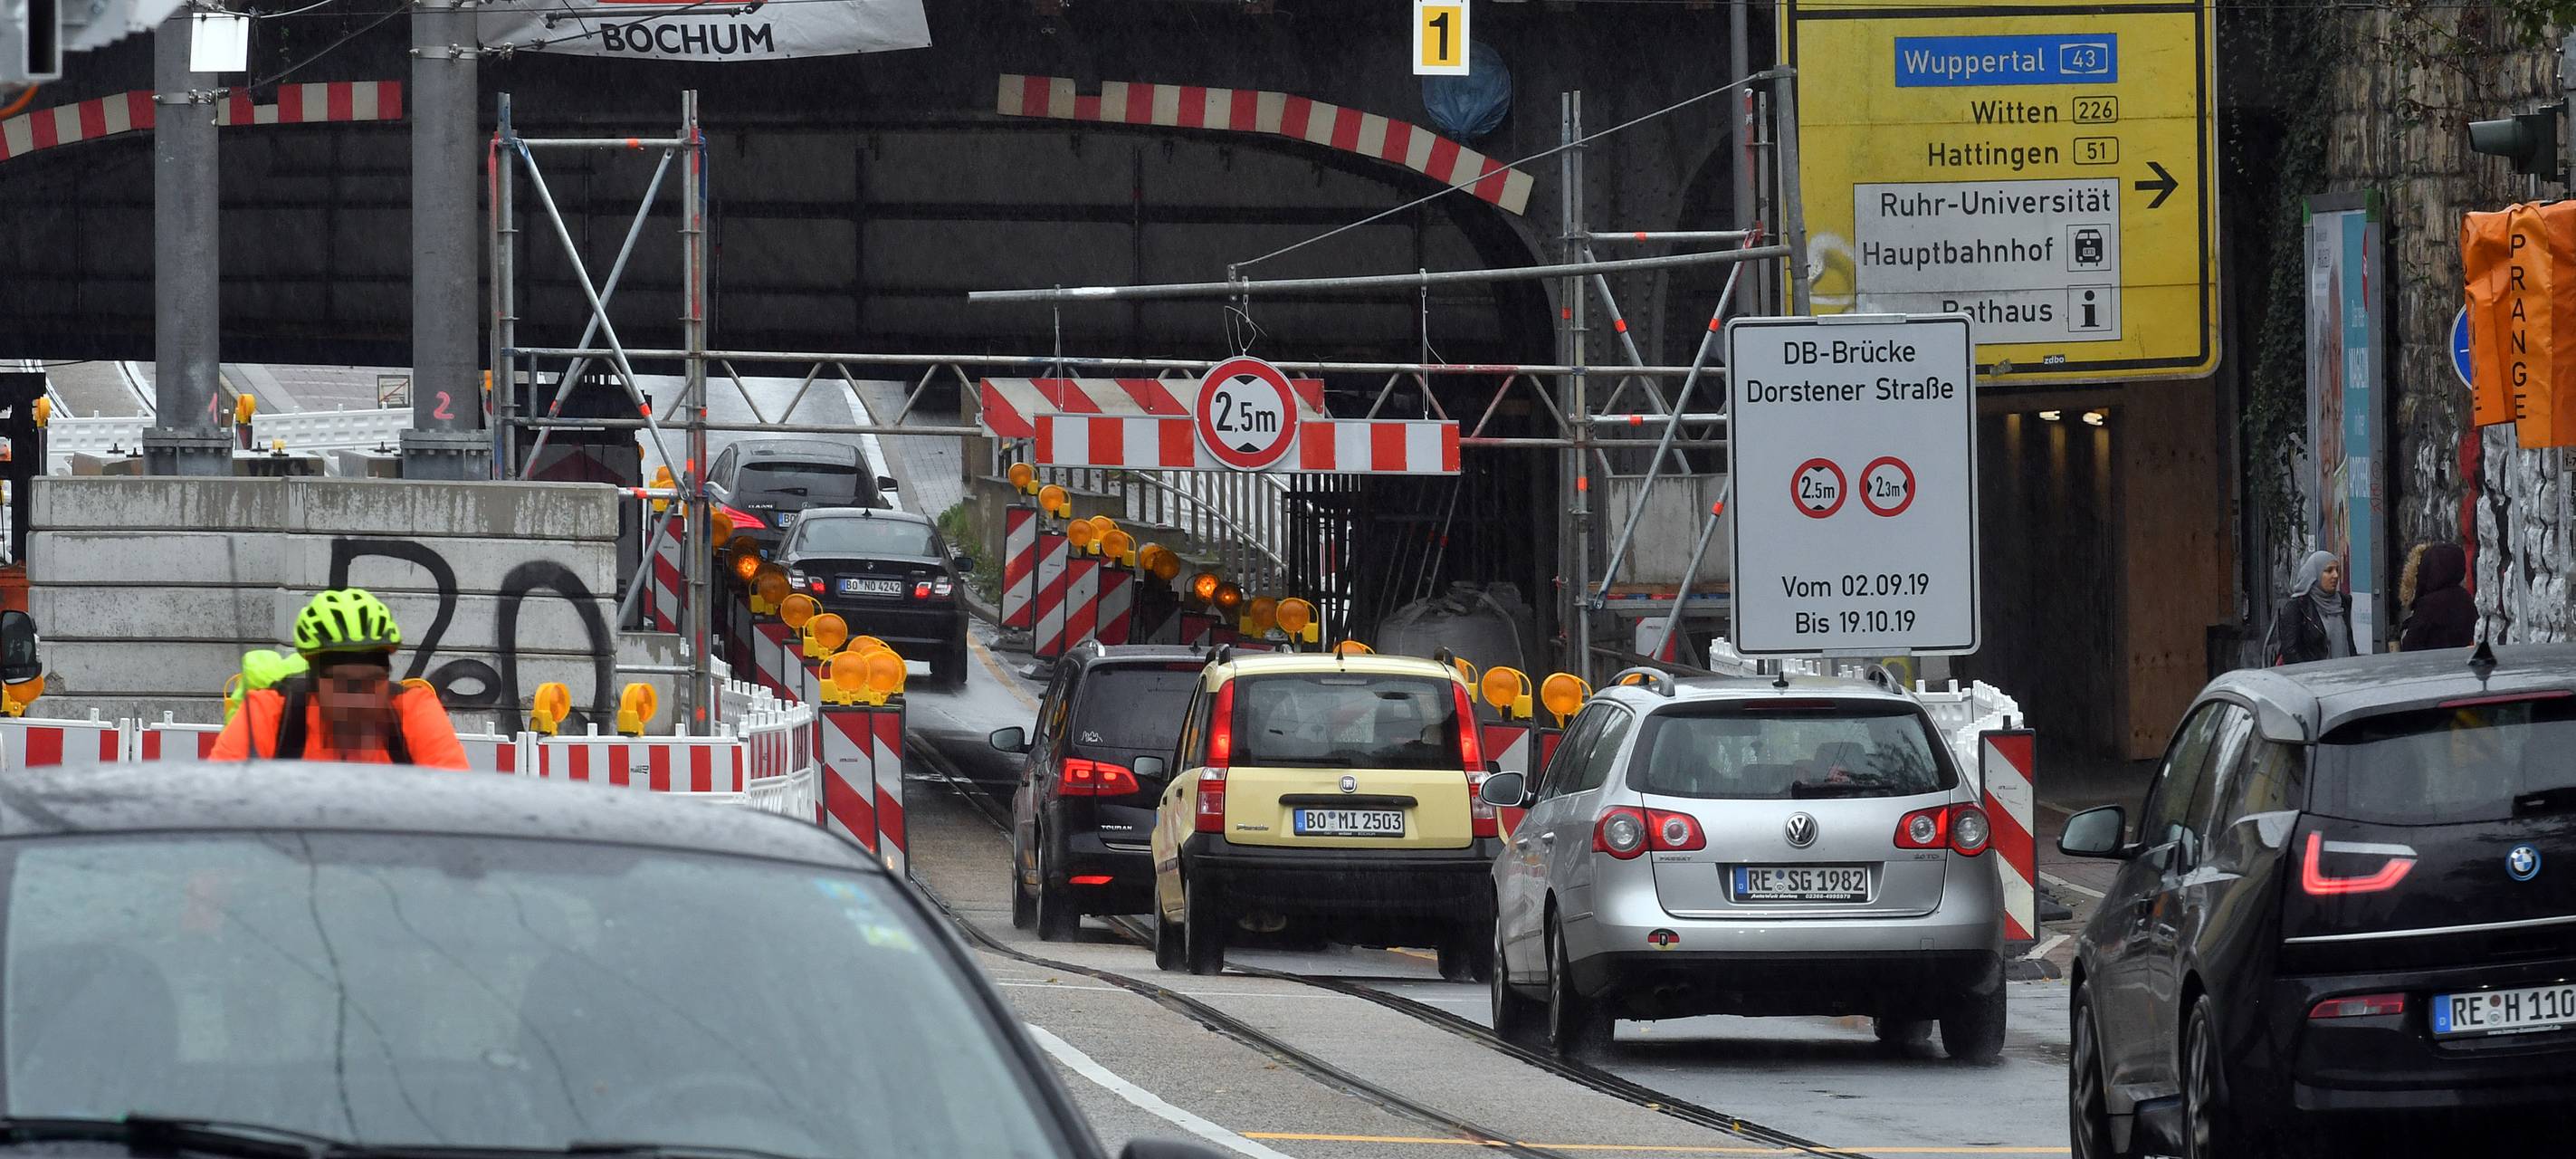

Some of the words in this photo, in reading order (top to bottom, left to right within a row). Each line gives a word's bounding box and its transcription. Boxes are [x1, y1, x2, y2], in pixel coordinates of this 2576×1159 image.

[600, 23, 776, 55] BOCHUM
[1428, 12, 1448, 61] 1
[1904, 47, 2046, 80] Wuppertal
[2072, 50, 2096, 68] 43
[1971, 101, 2058, 124] Witten
[2078, 101, 2113, 120] 226
[1928, 141, 2059, 171] Hattingen
[2086, 142, 2106, 159] 51
[1880, 187, 2112, 218] Ruhr-Universität
[1862, 236, 2054, 271] Hauptbahnhof
[2510, 234, 2527, 419] PRANGE
[1783, 340, 1916, 365] DB-Brücke
[2044, 356, 2065, 365] zdbo
[433, 390, 455, 420] 2
[1746, 380, 1866, 403] Dorstener
[1875, 377, 1954, 401] Straße
[1215, 390, 1277, 434] 2,5m
[846, 580, 858, 590] BO
[878, 581, 901, 593] 4242
[1781, 575, 1832, 598] Vom
[1841, 572, 1930, 597] 02.09.19
[1795, 611, 1830, 634] Bis
[1839, 609, 1916, 633] 19.10.19
[1306, 811, 1327, 829] BO
[1339, 812, 1359, 829] MI
[1362, 813, 1402, 830] 2503
[1748, 870, 1772, 891] RE
[1788, 870, 1811, 892] SG
[1817, 870, 1865, 892] 1982
[2452, 996, 2484, 1026] RE
[2504, 992, 2520, 1022] H
[2528, 989, 2575, 1020] 110
